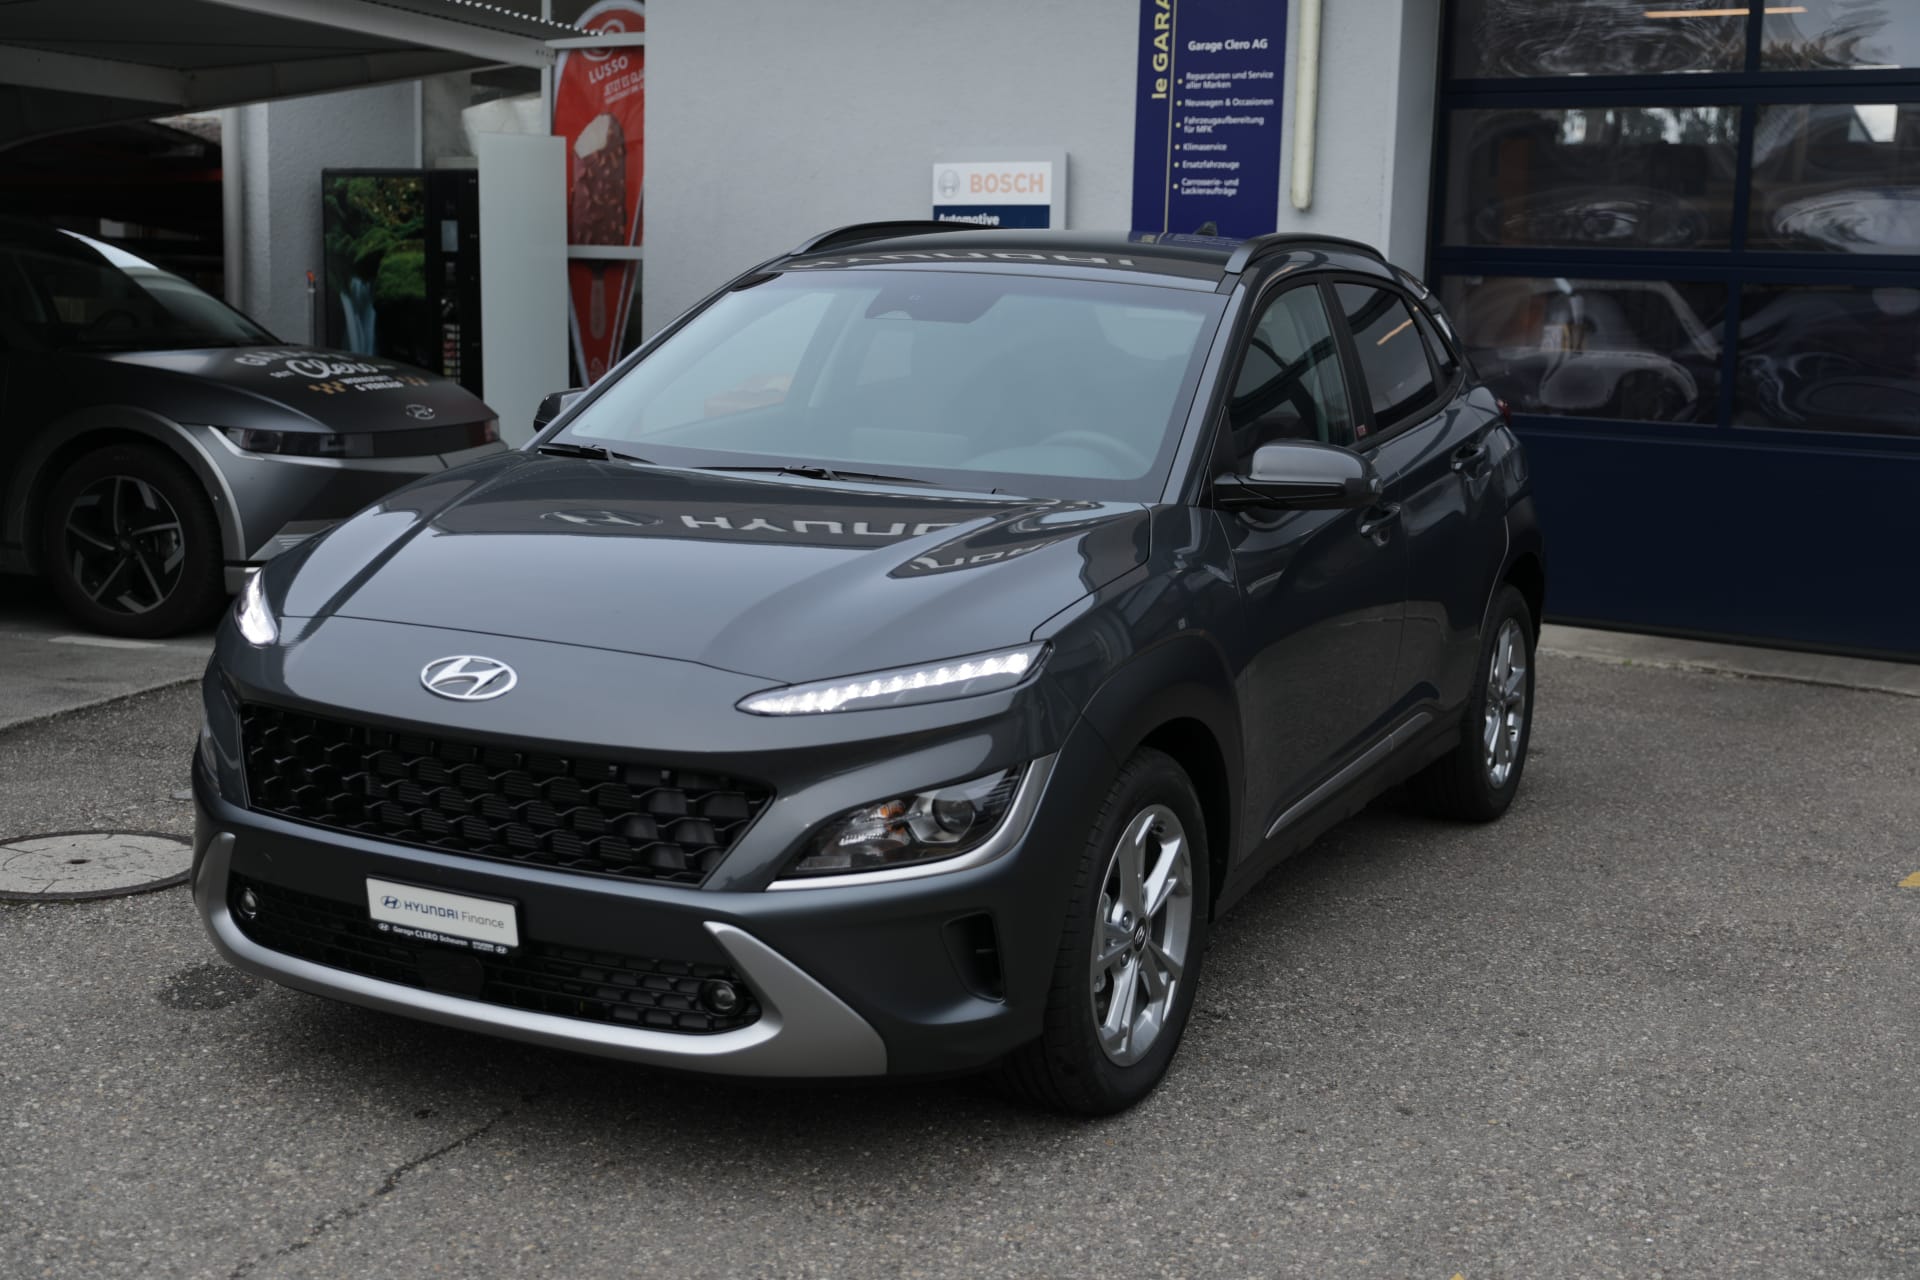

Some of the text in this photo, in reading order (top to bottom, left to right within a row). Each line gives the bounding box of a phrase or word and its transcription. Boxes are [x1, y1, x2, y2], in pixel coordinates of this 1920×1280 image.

[1188, 38, 1268, 53] Garage Clero AG
[588, 55, 629, 85] LUSSO
[1185, 69, 1274, 81] Reparaturen und Service
[1151, 78, 1168, 99] le
[1185, 80, 1231, 89] aller Marken
[1184, 97, 1274, 109] Neuwagen & Occasionen
[1183, 115, 1264, 126] Fahrzeugaufbereitung
[1183, 125, 1195, 134] für
[1183, 143, 1227, 152] Klimaservice
[1182, 160, 1240, 171] Ersatzfahrzeuge
[969, 172, 1045, 194] BOSCH
[1224, 177, 1239, 187] und
[1181, 186, 1237, 197] Lackieraufträge
[404, 900, 505, 929] HYUNDAI Finance
[393, 925, 415, 937] Garage
[415, 929, 439, 942] CLERO
